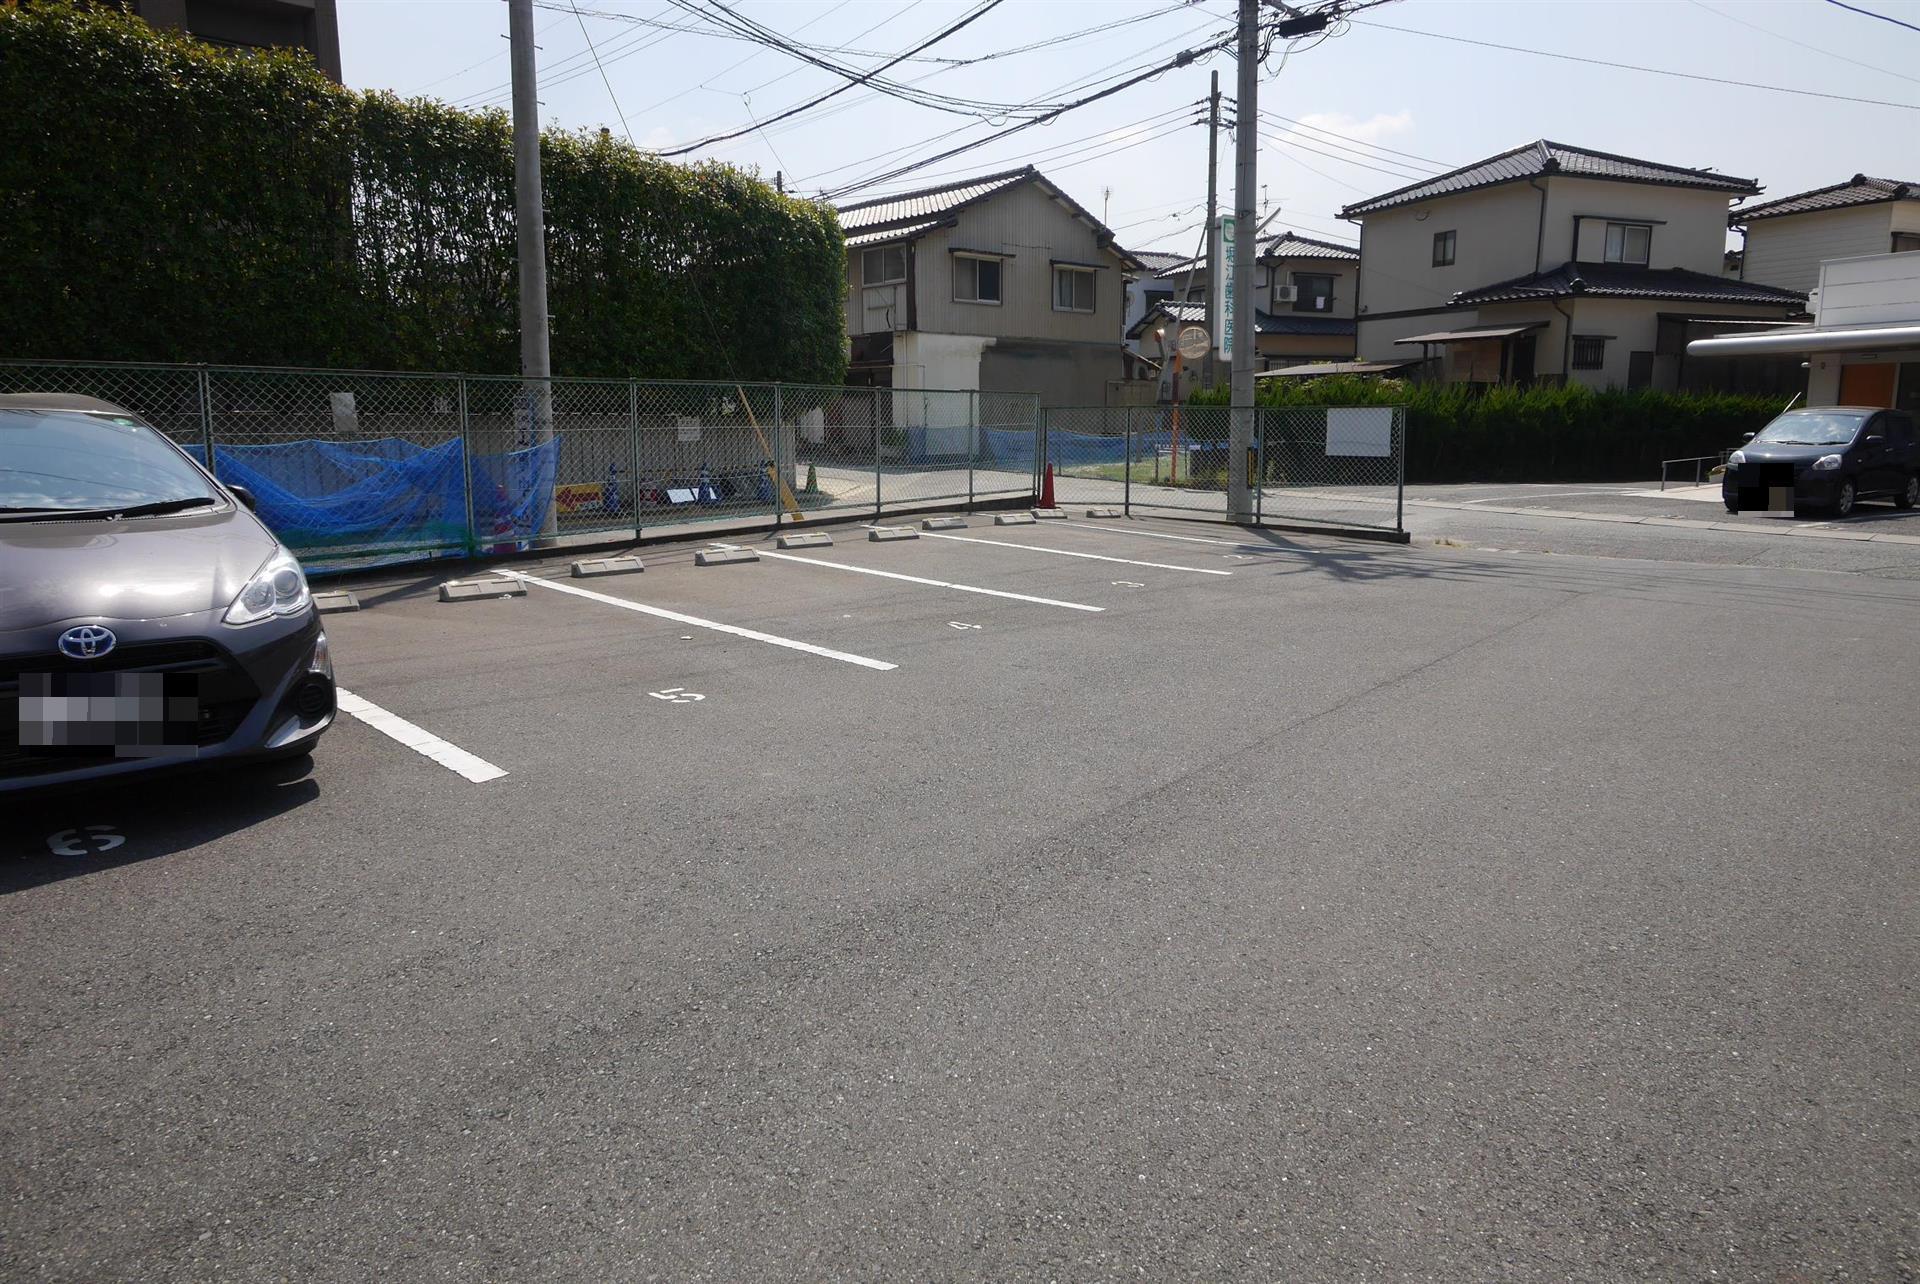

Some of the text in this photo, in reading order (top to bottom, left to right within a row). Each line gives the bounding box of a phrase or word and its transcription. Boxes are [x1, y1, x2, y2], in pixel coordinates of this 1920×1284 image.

[1111, 580, 1145, 588] 3
[946, 621, 983, 630] 4
[648, 687, 706, 703] 5
[46, 825, 126, 856] 6
